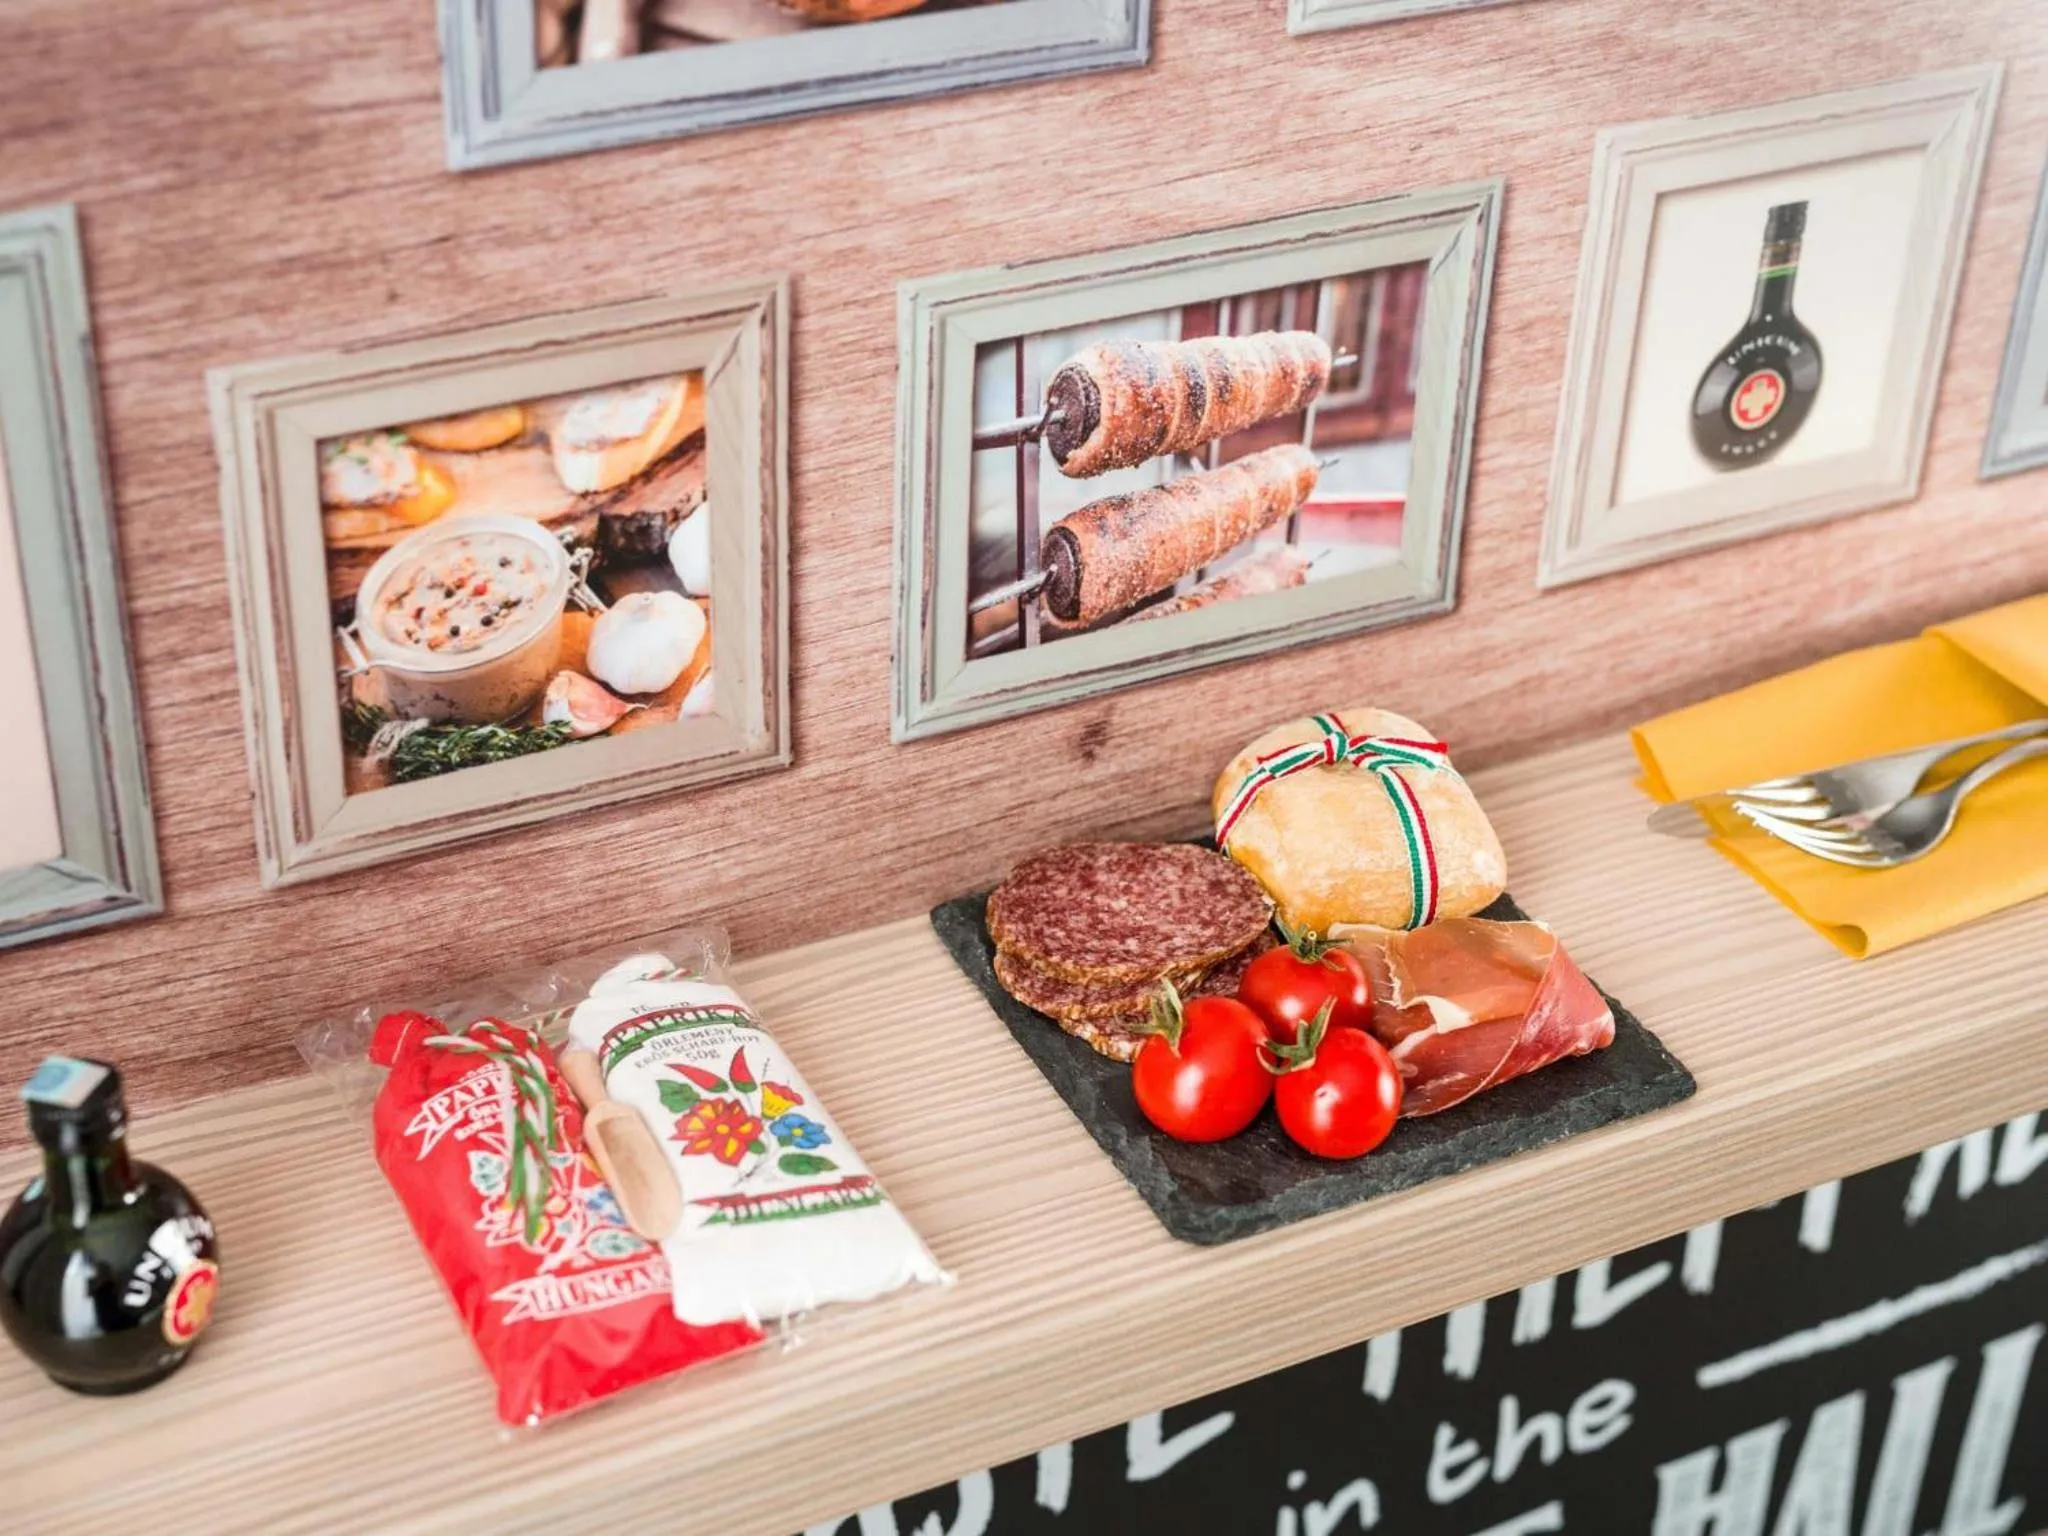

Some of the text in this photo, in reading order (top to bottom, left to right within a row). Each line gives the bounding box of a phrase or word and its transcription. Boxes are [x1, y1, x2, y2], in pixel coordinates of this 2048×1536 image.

[1276, 1469, 1382, 1536] in
[1426, 1378, 1637, 1505] the
[1650, 1323, 2047, 1536] HALL
